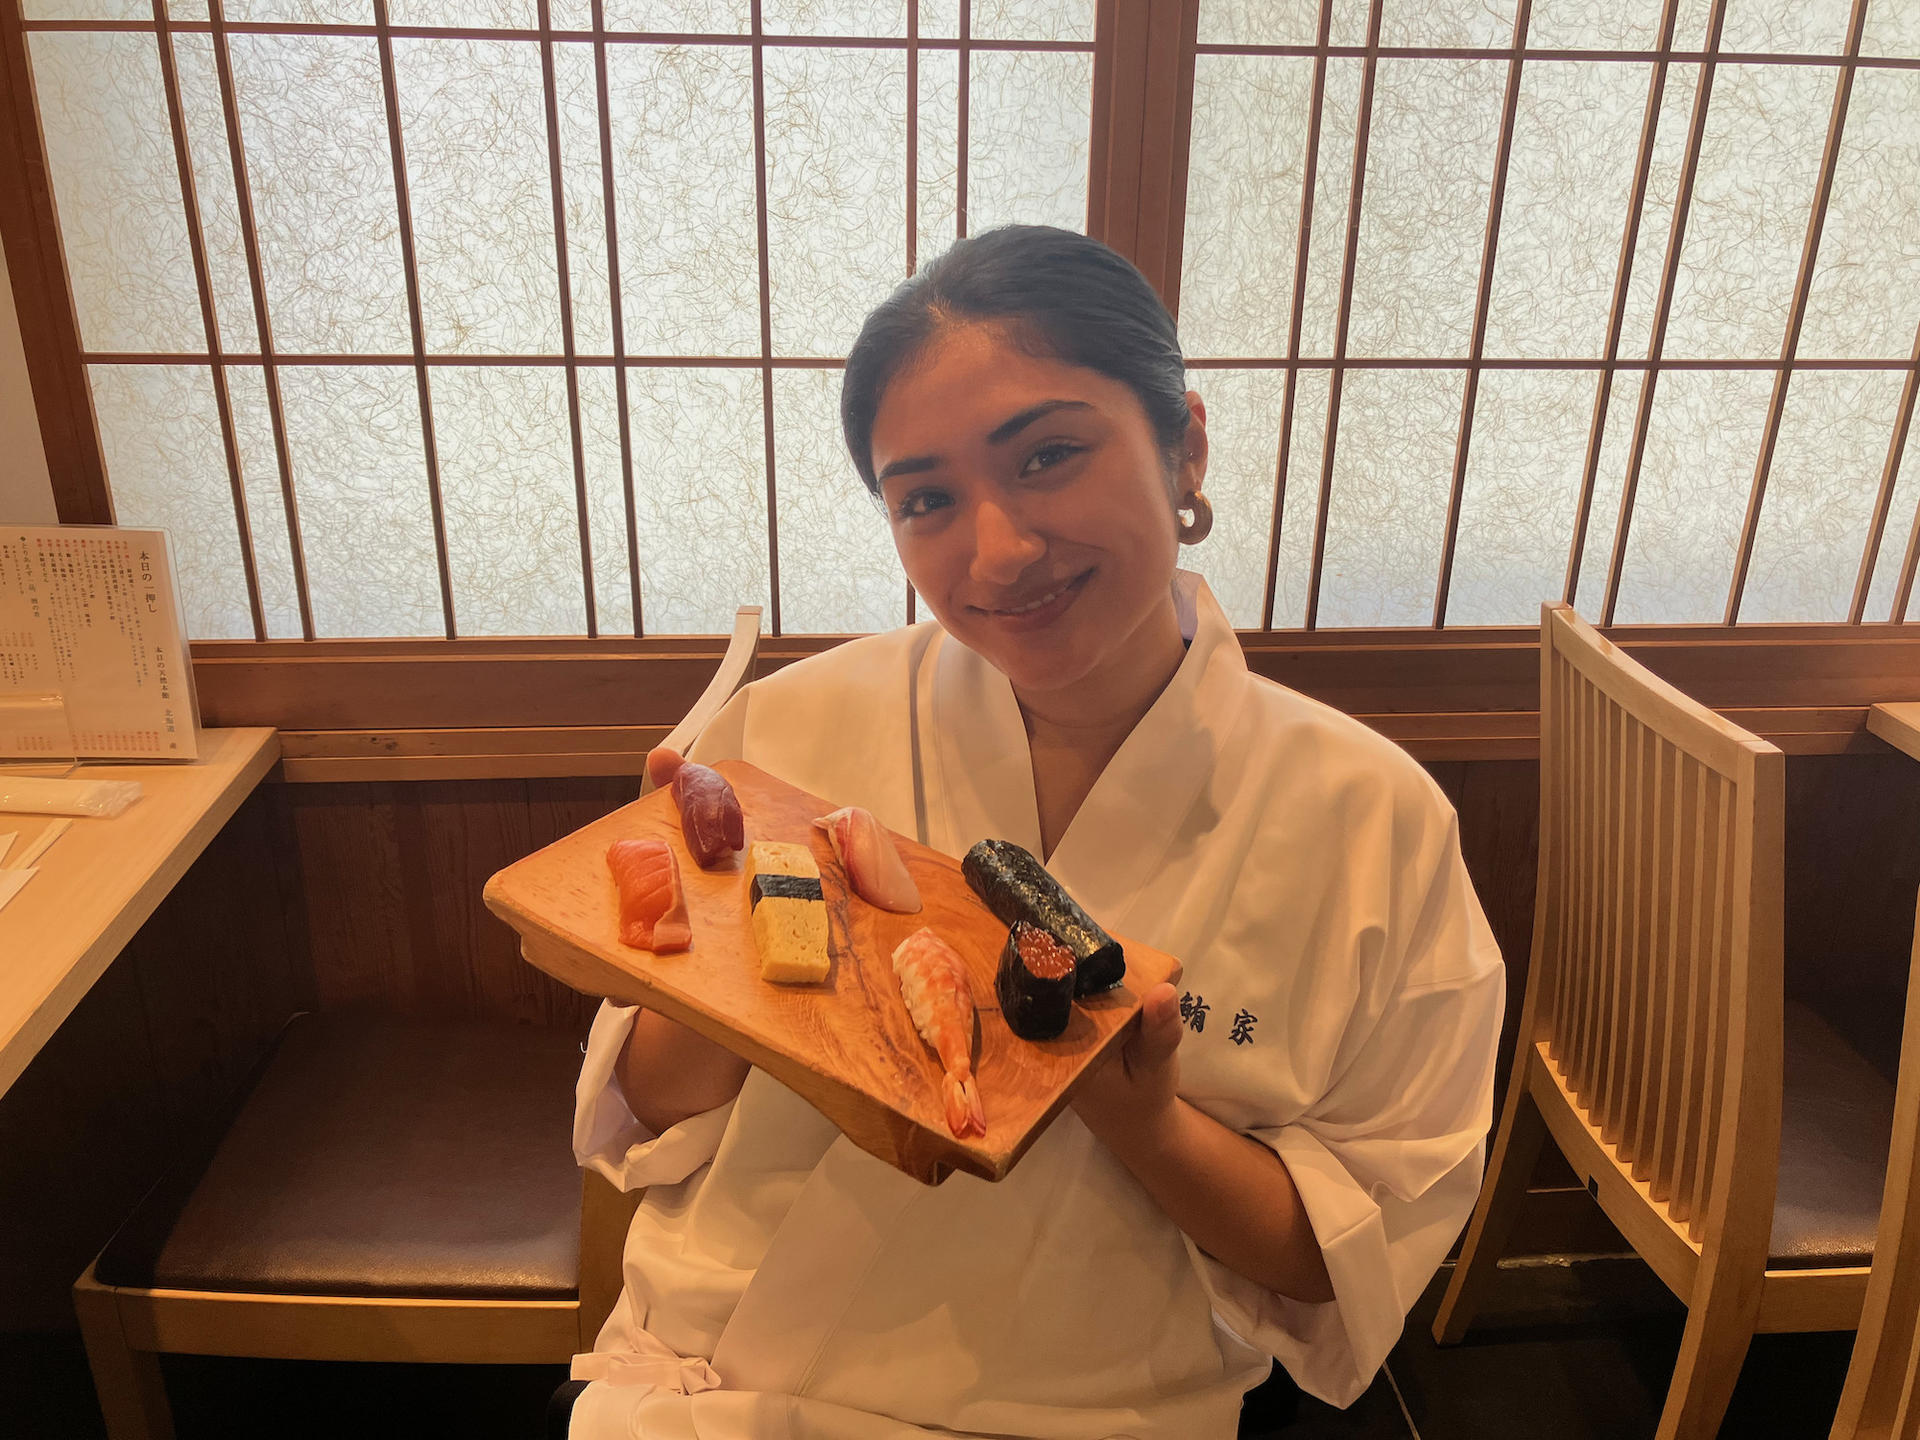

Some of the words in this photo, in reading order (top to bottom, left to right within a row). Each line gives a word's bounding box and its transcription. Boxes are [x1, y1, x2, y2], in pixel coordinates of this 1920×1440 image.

[139, 550, 158, 613] 本日の一押し
